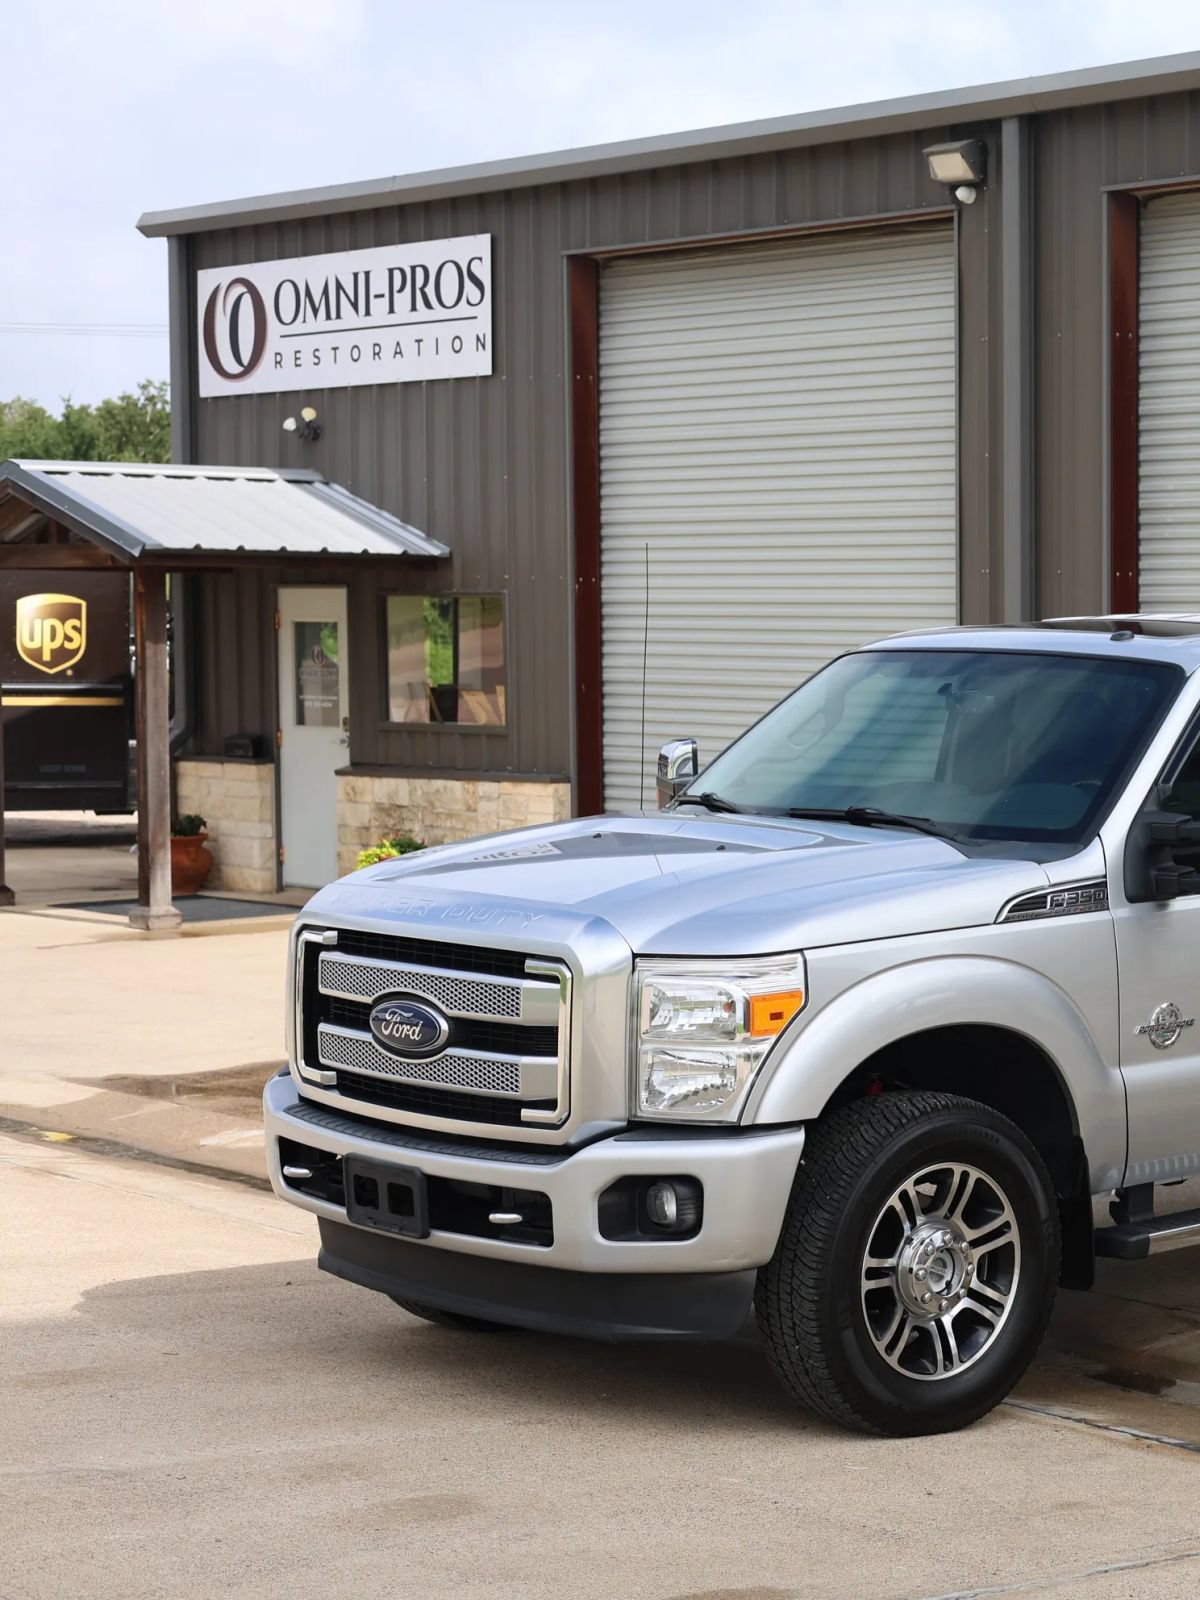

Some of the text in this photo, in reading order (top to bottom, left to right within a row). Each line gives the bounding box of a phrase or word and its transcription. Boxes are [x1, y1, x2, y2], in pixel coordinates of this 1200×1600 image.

[273, 256, 486, 326] OMNI-PROS
[274, 332, 487, 370] RESTORATION
[21, 618, 82, 662] ups
[439, 902, 545, 929] DUTY
[381, 1007, 424, 1042] Ford
